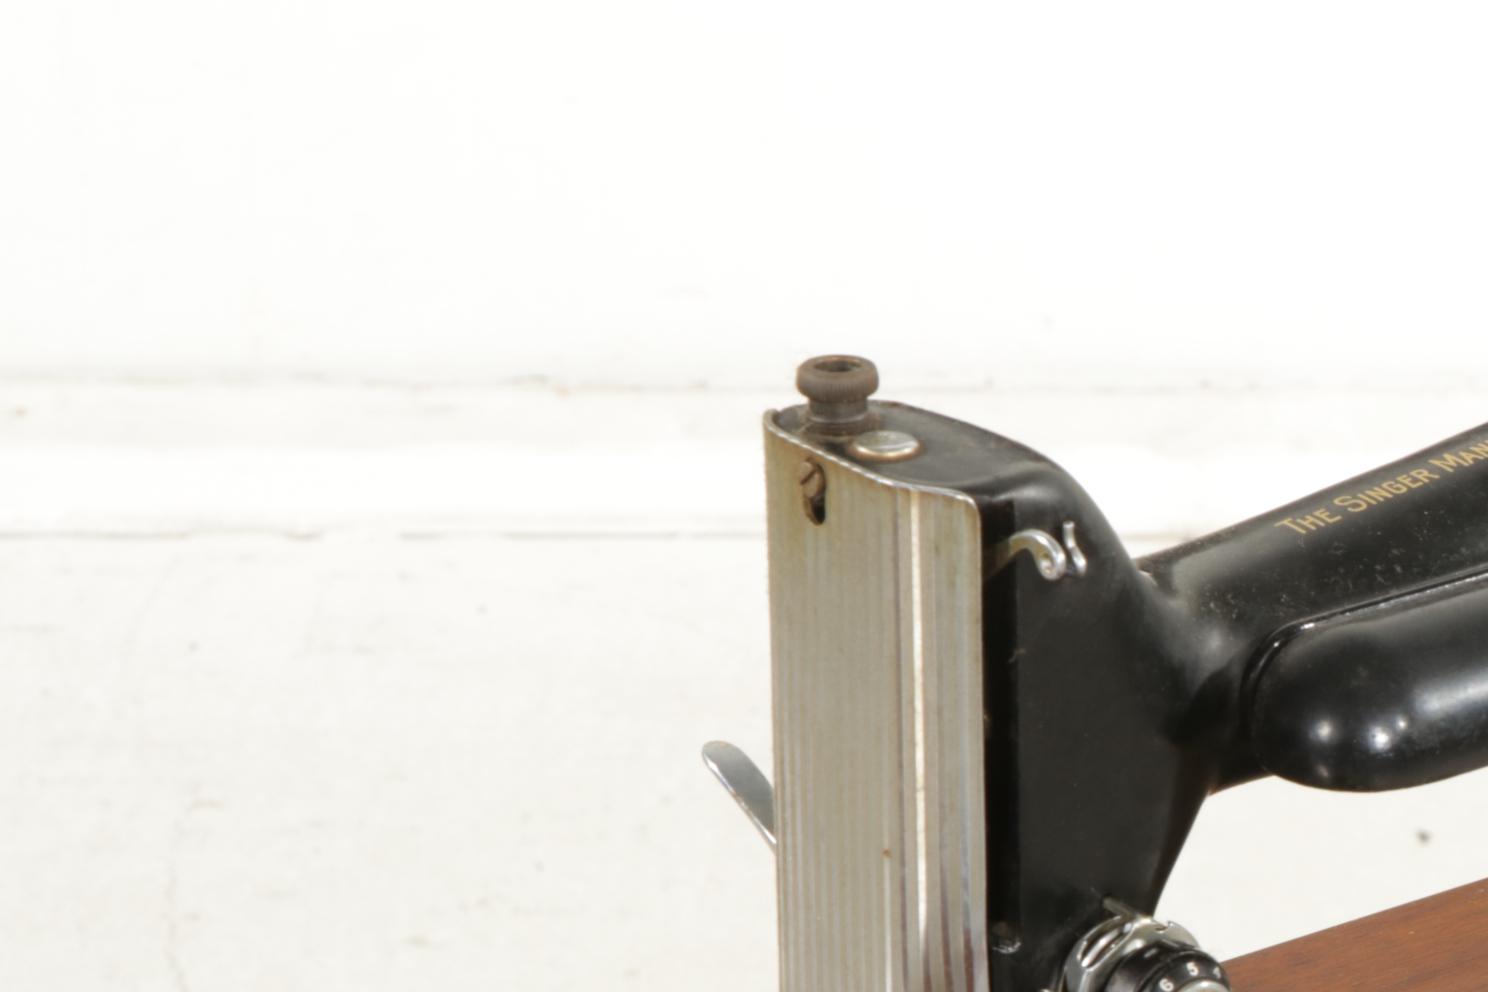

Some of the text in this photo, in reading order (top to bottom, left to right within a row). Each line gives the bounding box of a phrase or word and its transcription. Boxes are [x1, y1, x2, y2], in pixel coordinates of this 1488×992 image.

[1274, 508, 1342, 536] THE
[1333, 468, 1441, 513] SINGER
[1158, 978, 1174, 992] 6
[1185, 961, 1199, 977] 5
